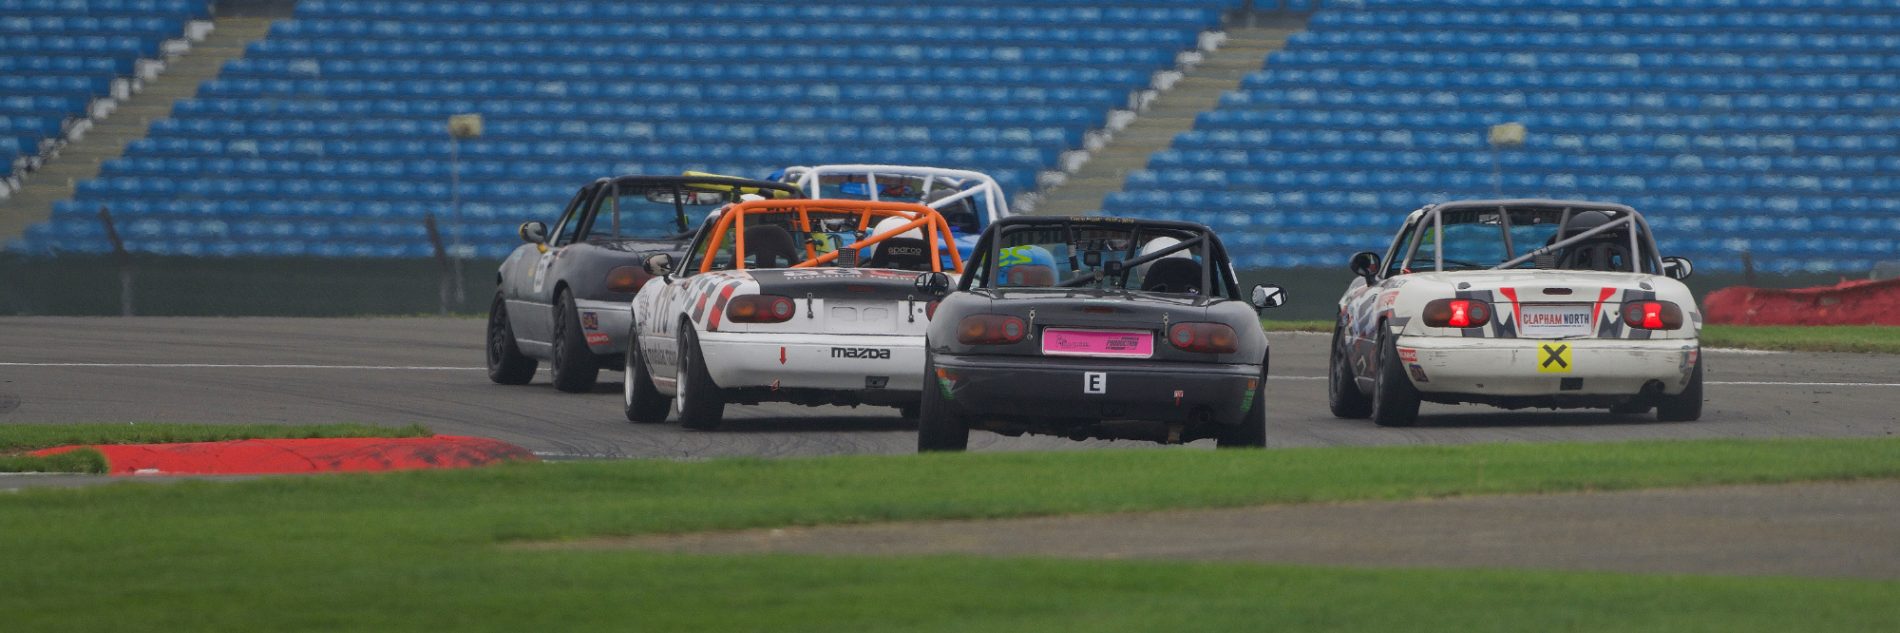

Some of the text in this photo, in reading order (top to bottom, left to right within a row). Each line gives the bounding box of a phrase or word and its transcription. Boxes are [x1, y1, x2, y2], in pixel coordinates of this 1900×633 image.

[888, 246, 922, 255] sparco
[1523, 313, 1590, 325] CLAPHAM NORTH
[830, 347, 890, 359] mazda
[1089, 375, 1101, 391] E
